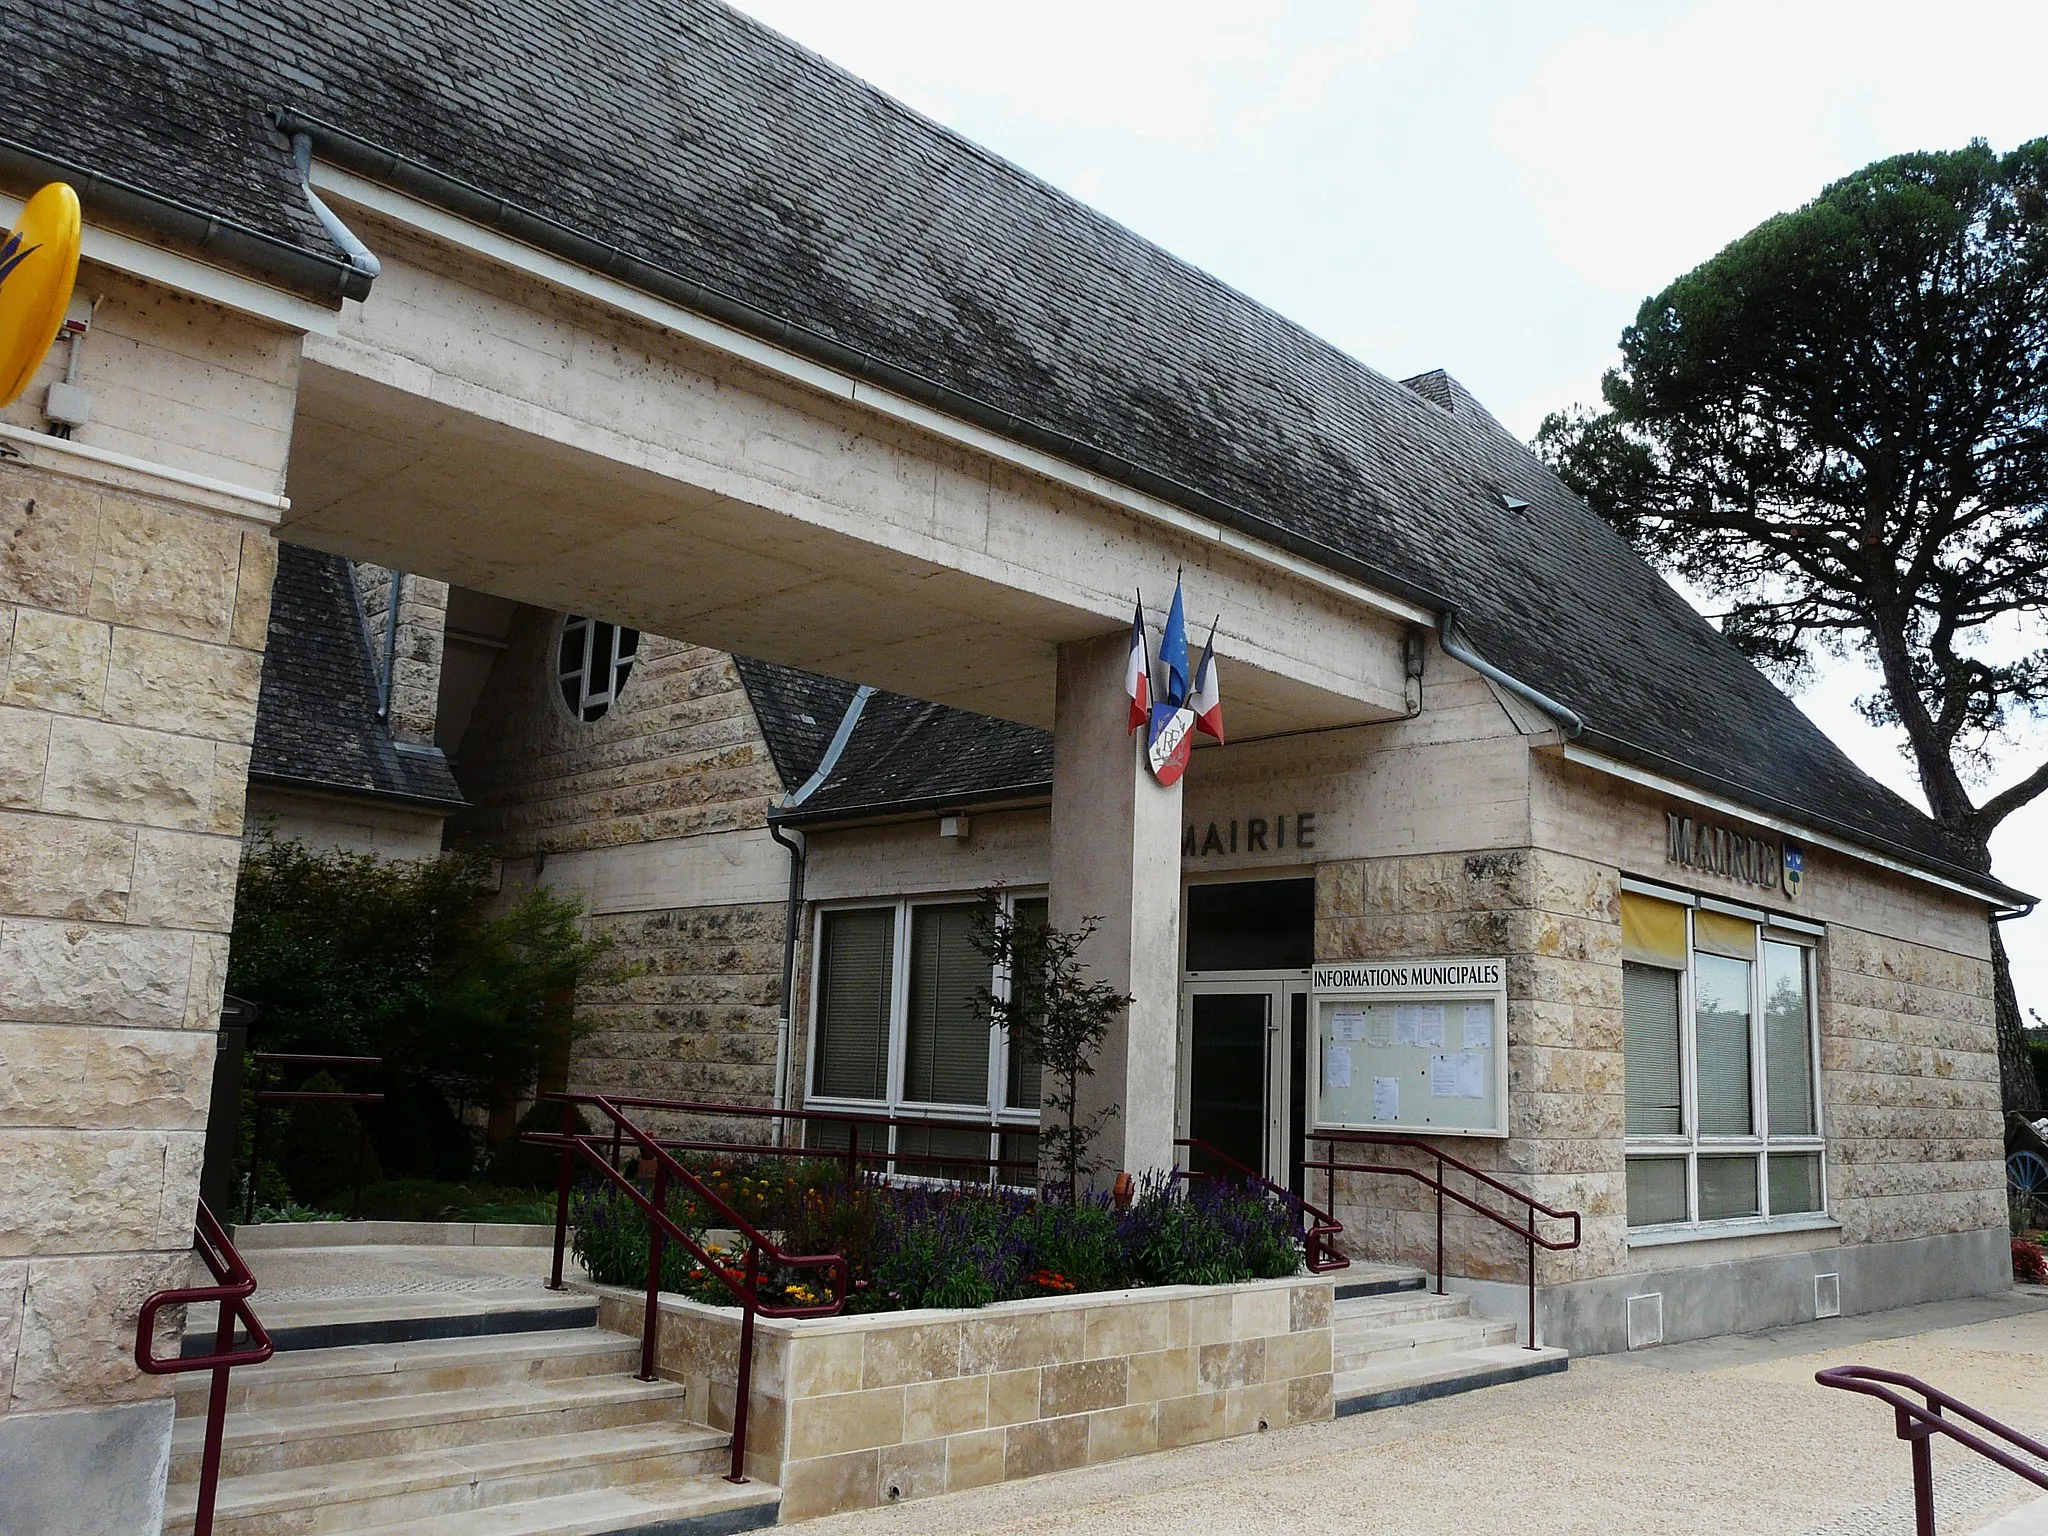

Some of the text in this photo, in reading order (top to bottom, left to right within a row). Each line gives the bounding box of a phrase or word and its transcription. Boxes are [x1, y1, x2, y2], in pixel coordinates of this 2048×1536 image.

[1667, 812, 1777, 889] MAIRIE
[1314, 965, 1499, 987] INFORMATIONS MUNICIPALES
